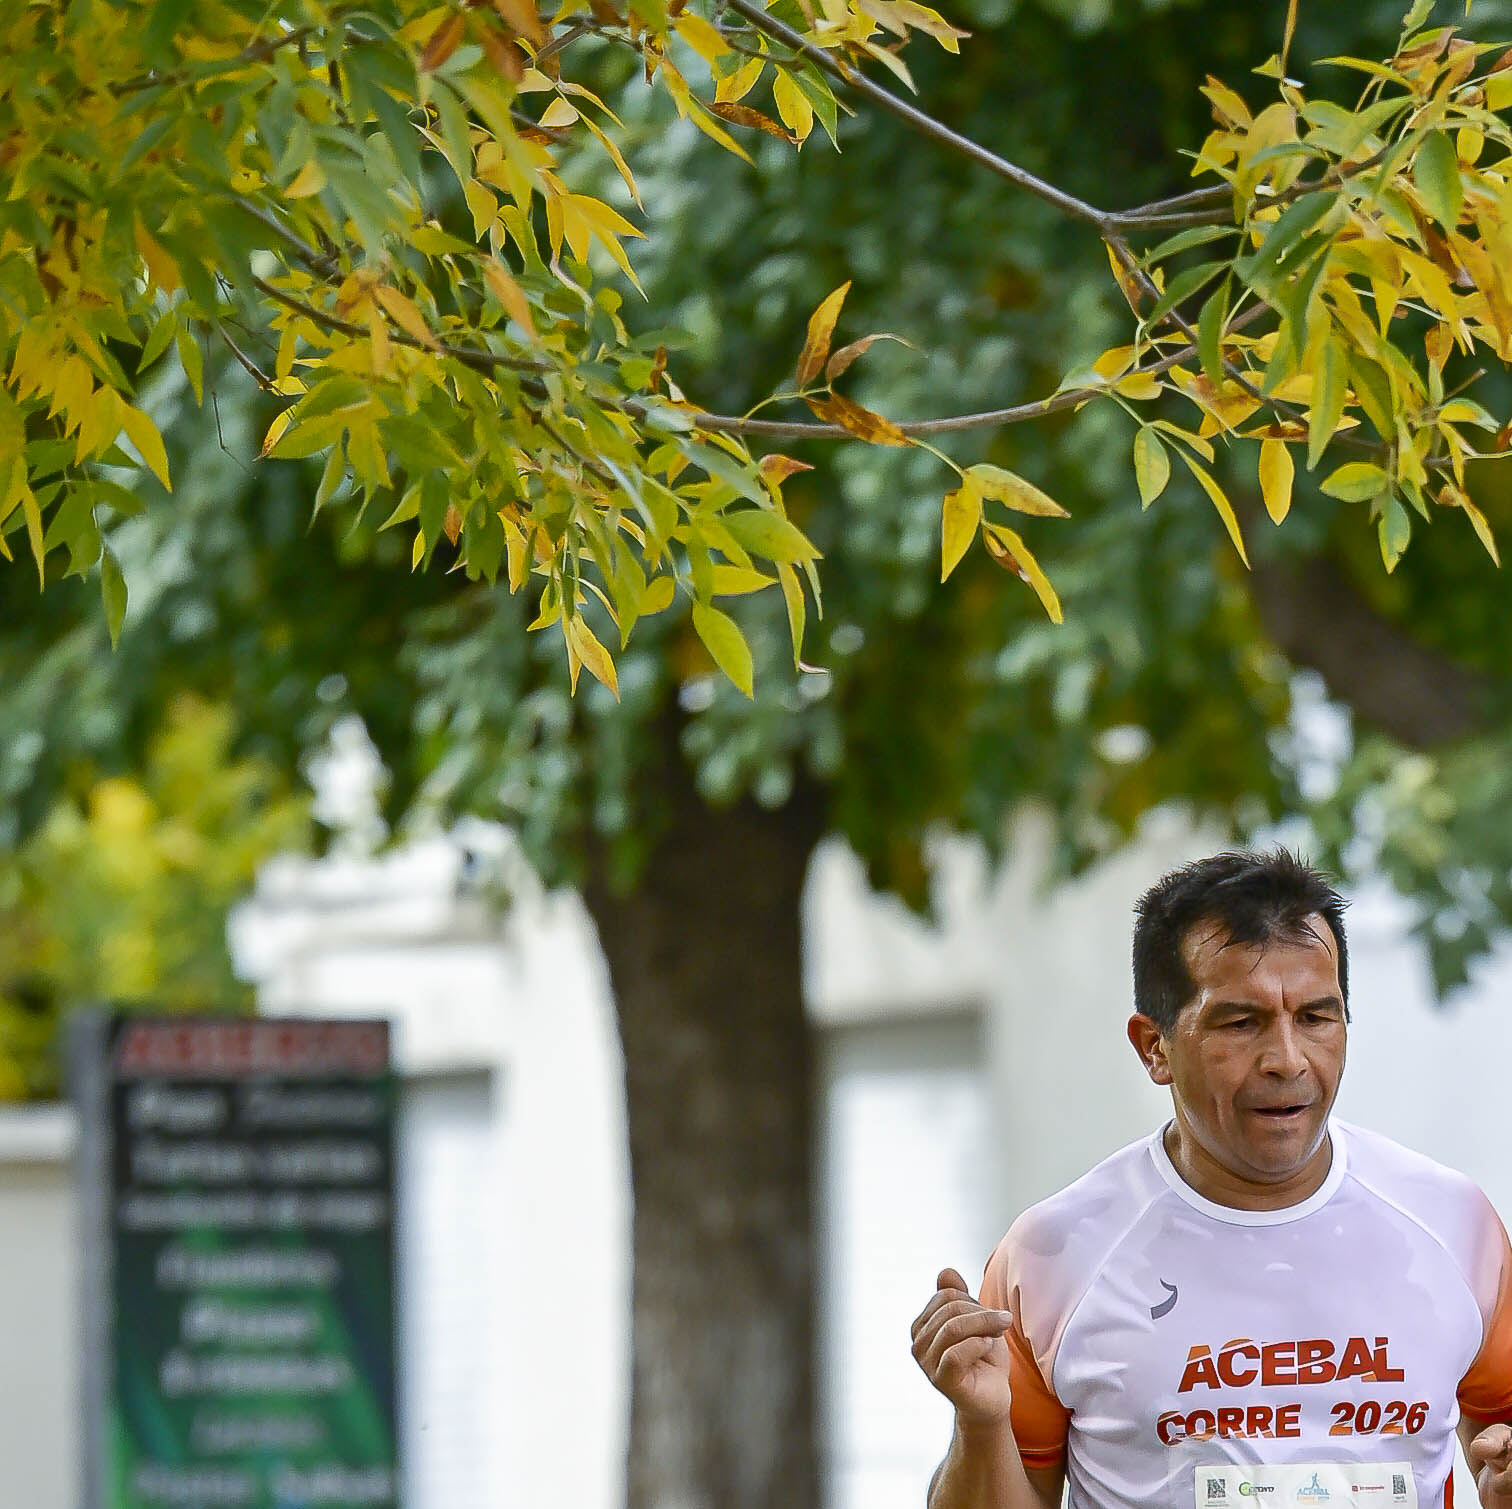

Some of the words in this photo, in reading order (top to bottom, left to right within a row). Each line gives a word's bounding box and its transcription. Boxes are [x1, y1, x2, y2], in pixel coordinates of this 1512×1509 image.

[1177, 1336, 1405, 1393] ACEBAL
[1156, 1403, 1302, 1447] CORRE
[1329, 1400, 1430, 1437] 2026
